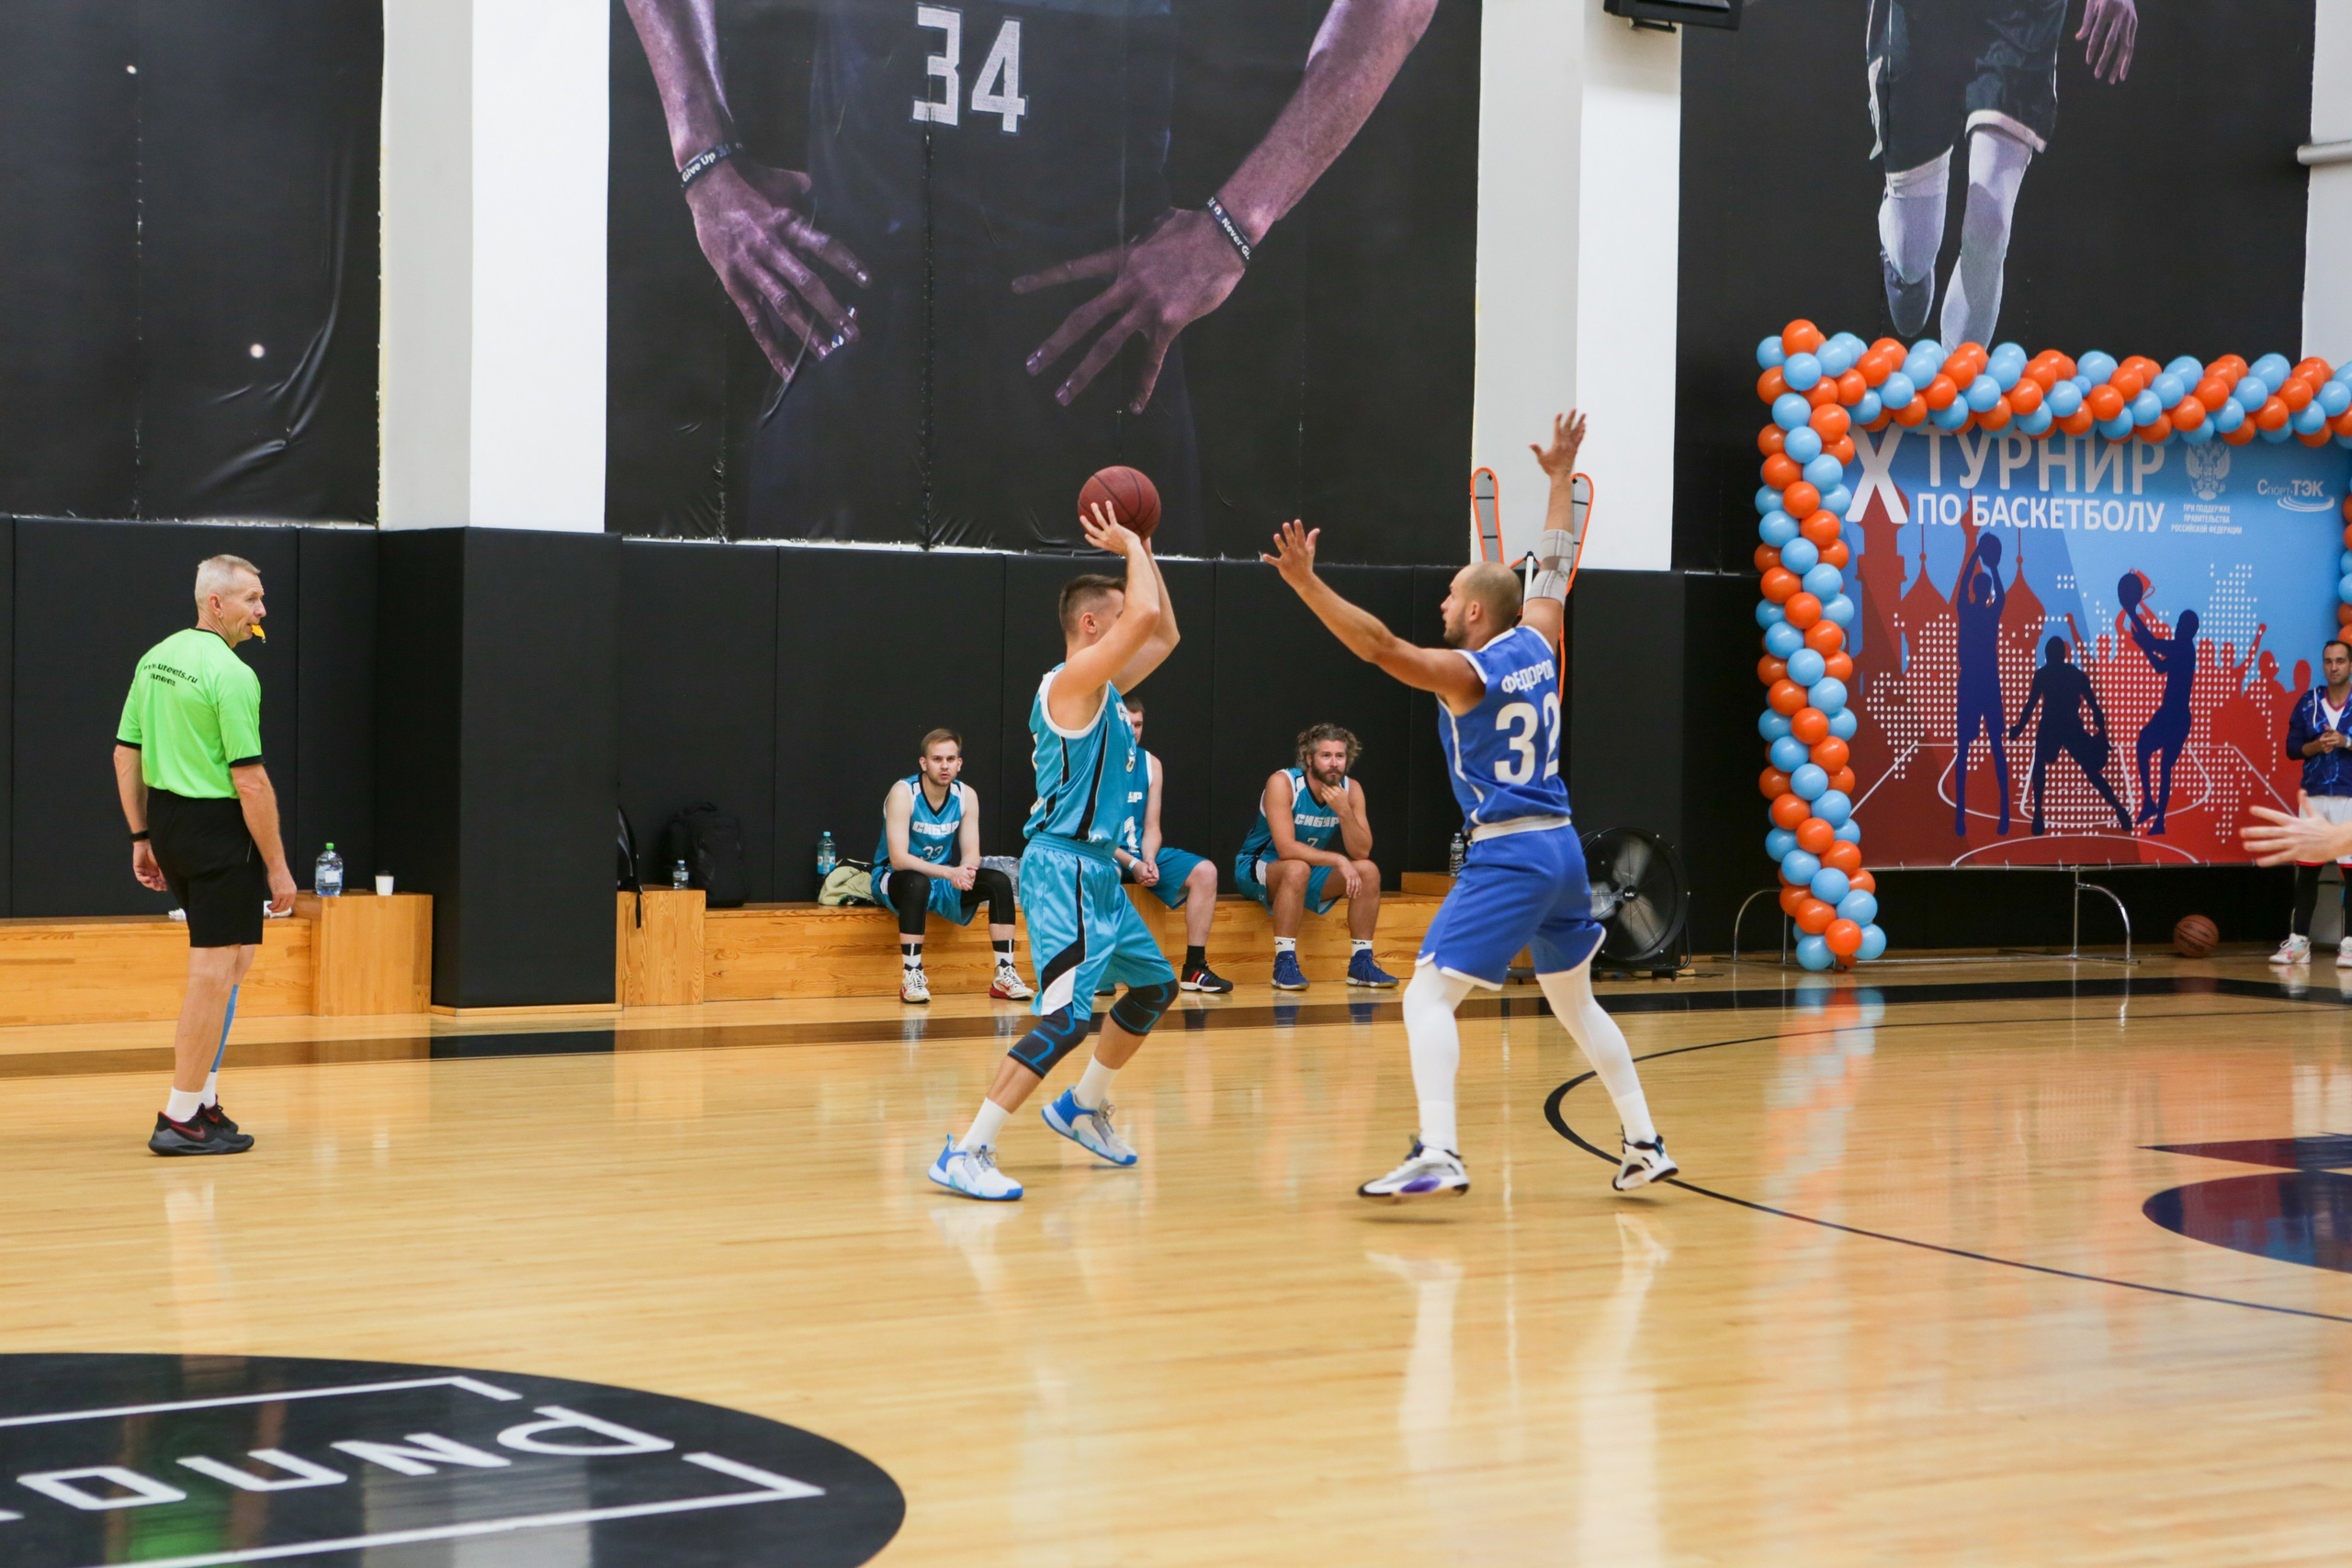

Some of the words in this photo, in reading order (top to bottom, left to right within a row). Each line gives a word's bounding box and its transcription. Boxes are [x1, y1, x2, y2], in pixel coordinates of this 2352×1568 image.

[912, 5, 1026, 133] 34
[682, 163, 701, 183] Give
[700, 152, 717, 166] Up
[1221, 217, 1243, 246] Never
[1845, 423, 1908, 525] X
[1917, 423, 2165, 495] ТУРНИР
[1917, 492, 1962, 526] ПО
[1972, 495, 2165, 534] БАСКЕТБОЛУ
[2183, 502, 2195, 513] ПРИ
[2196, 503, 2231, 513] ПОДДЕРЖКЕ
[2183, 513, 2230, 524] ПРАВИТЕЛЬСТВА
[2171, 524, 2208, 534] РОССИЙСКОЙ
[2209, 525, 2243, 536] ФЕДЕРАЦИИ
[1494, 691, 1561, 787] 32
[911, 820, 960, 836] СИБУР
[1294, 813, 1340, 829] СИБУР
